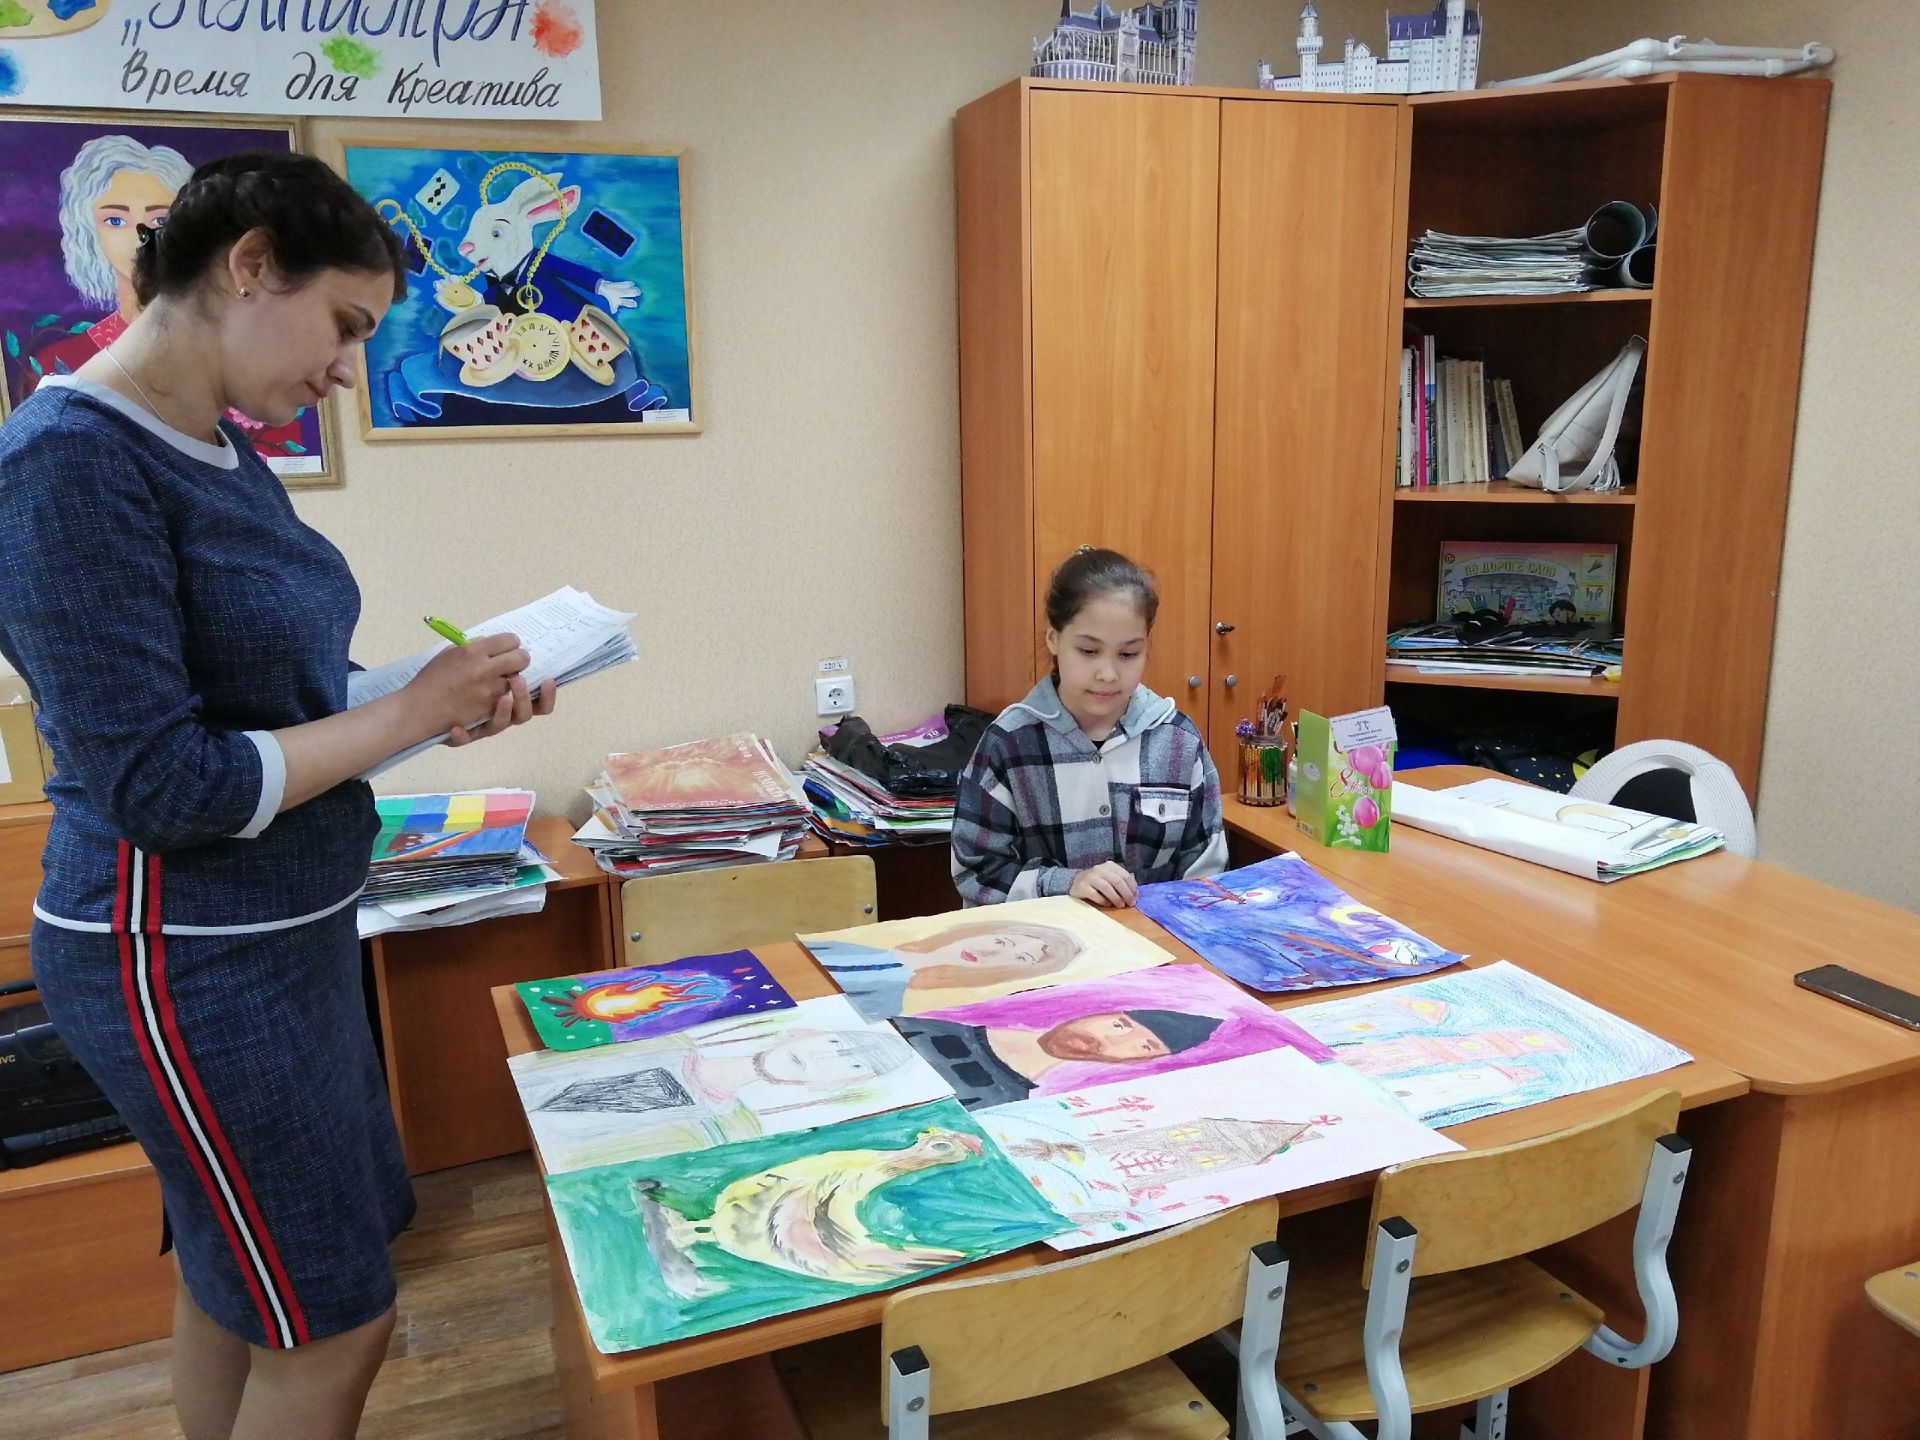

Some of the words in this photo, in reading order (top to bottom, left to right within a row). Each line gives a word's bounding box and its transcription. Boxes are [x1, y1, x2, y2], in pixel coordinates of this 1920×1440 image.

[121, 48, 251, 103] Время
[286, 51, 360, 101] для
[387, 63, 563, 113] Креатива
